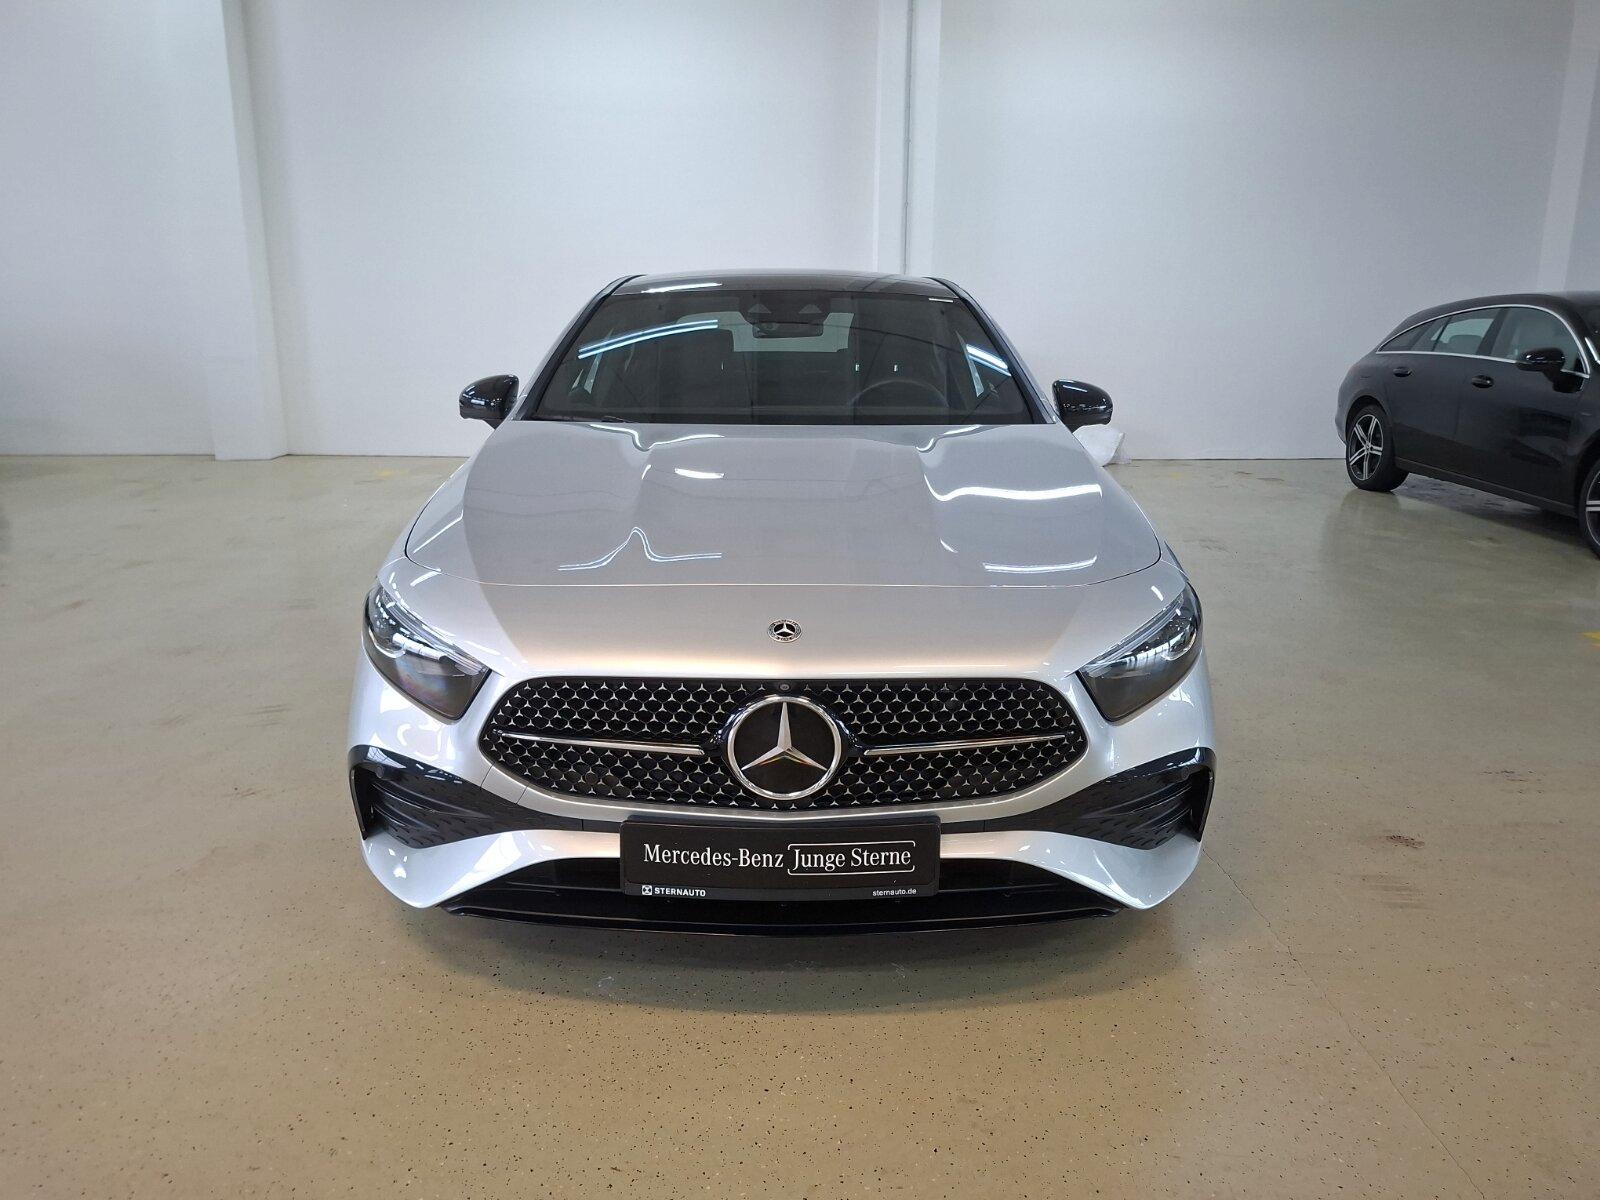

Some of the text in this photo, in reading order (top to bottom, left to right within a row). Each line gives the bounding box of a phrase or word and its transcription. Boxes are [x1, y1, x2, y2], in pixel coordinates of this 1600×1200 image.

[643, 843, 911, 872] Mercedes-Benz Junge Sterne
[654, 886, 706, 897] STERNAUTO
[872, 887, 917, 897] sternauto.de
